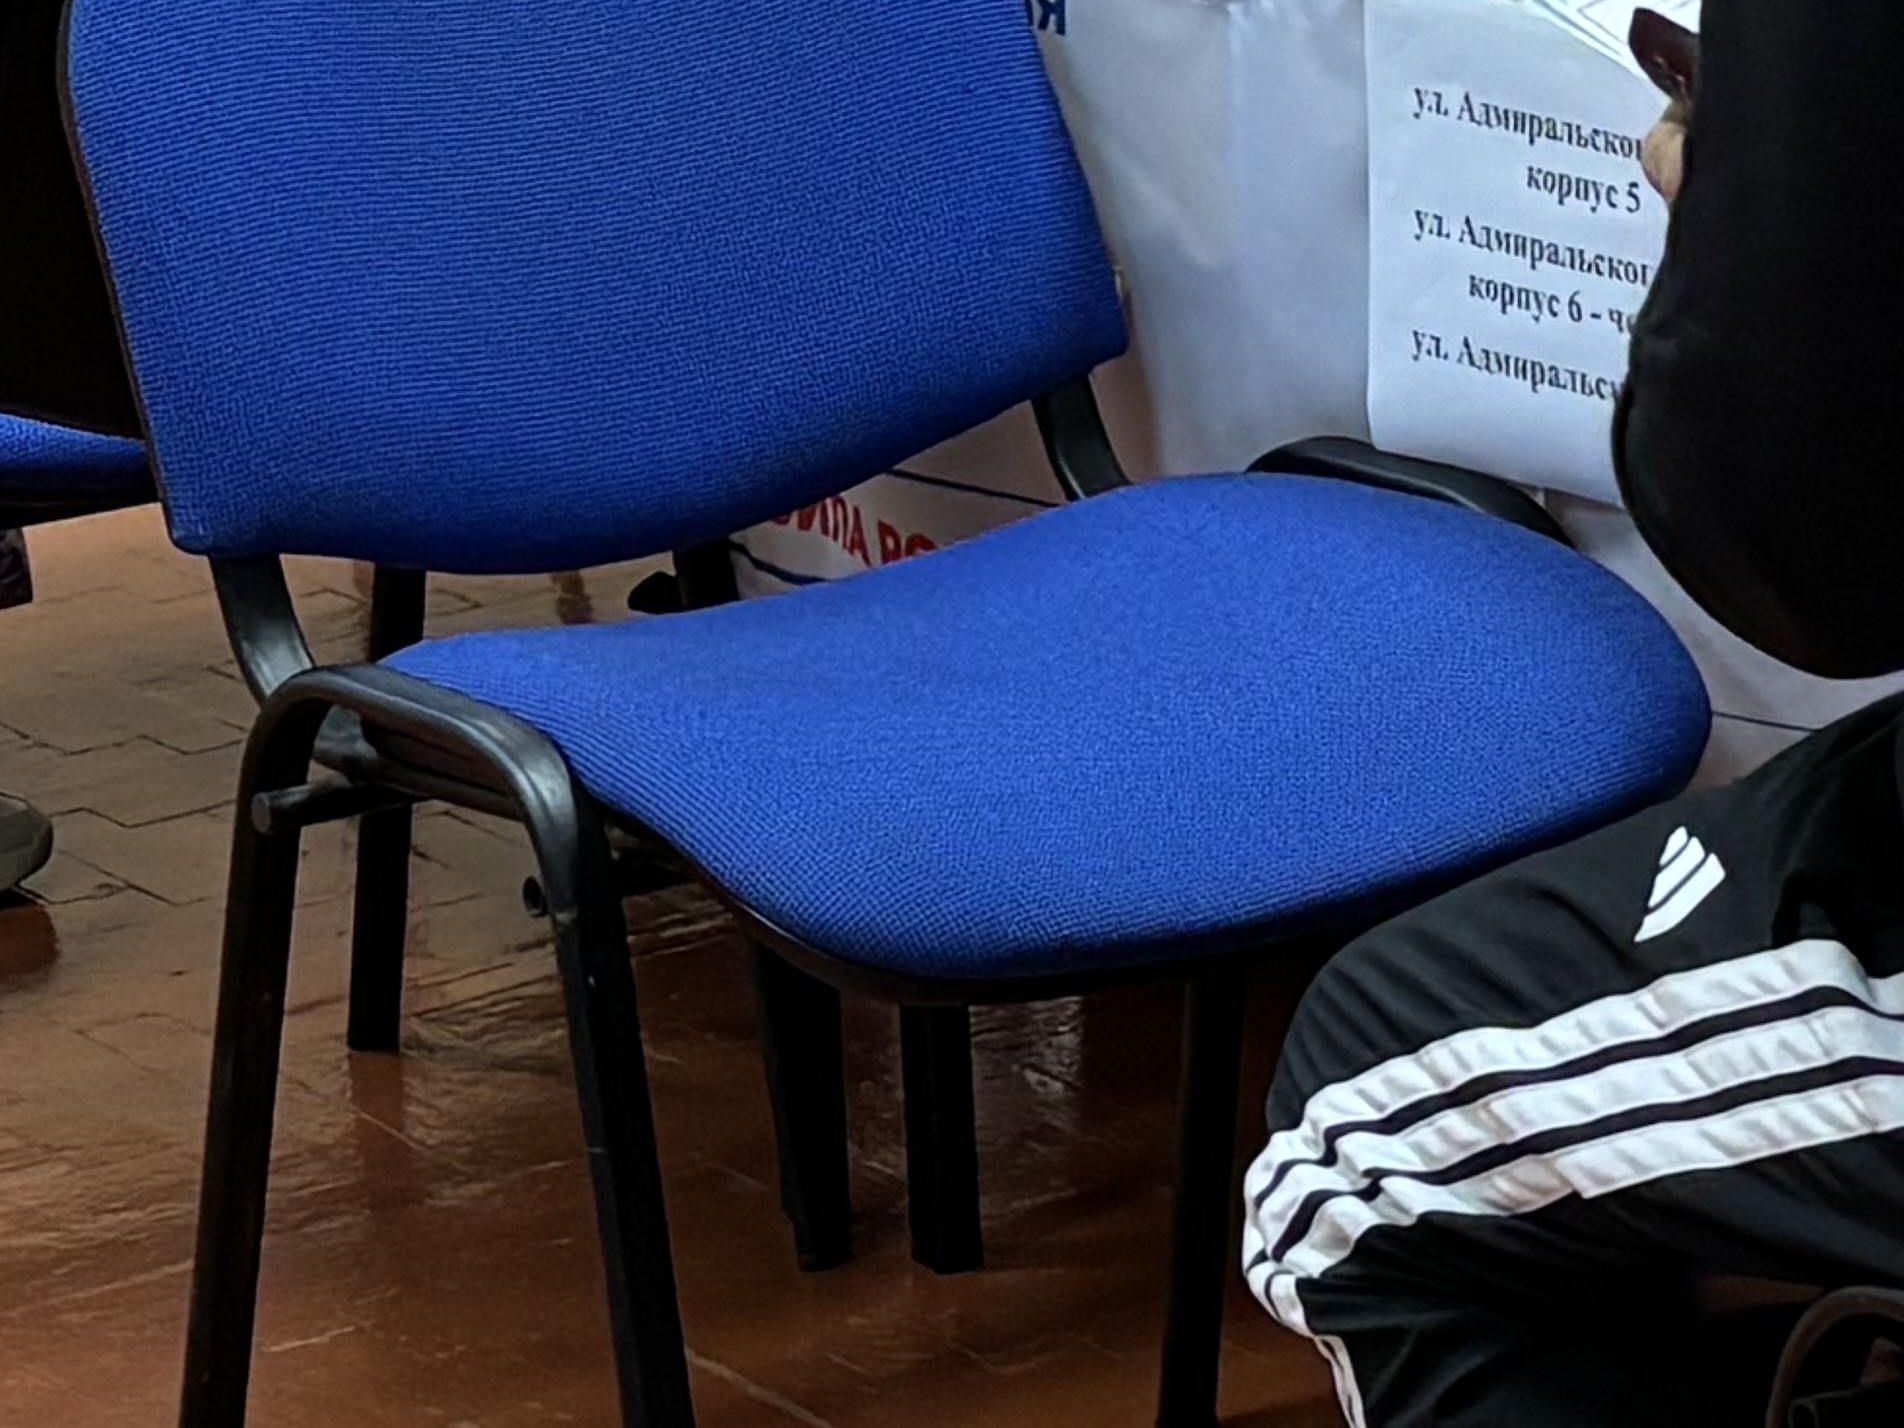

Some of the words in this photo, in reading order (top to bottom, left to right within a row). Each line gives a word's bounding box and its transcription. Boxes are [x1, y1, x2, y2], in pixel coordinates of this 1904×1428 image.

[1413, 88, 1448, 119] ул.
[1527, 165, 1618, 213] корпус
[1626, 182, 1641, 213] 5
[1414, 209, 1450, 241] ул.
[1469, 274, 1560, 323] корпус
[1568, 290, 1583, 323] 6
[1412, 330, 1448, 361] ул.
